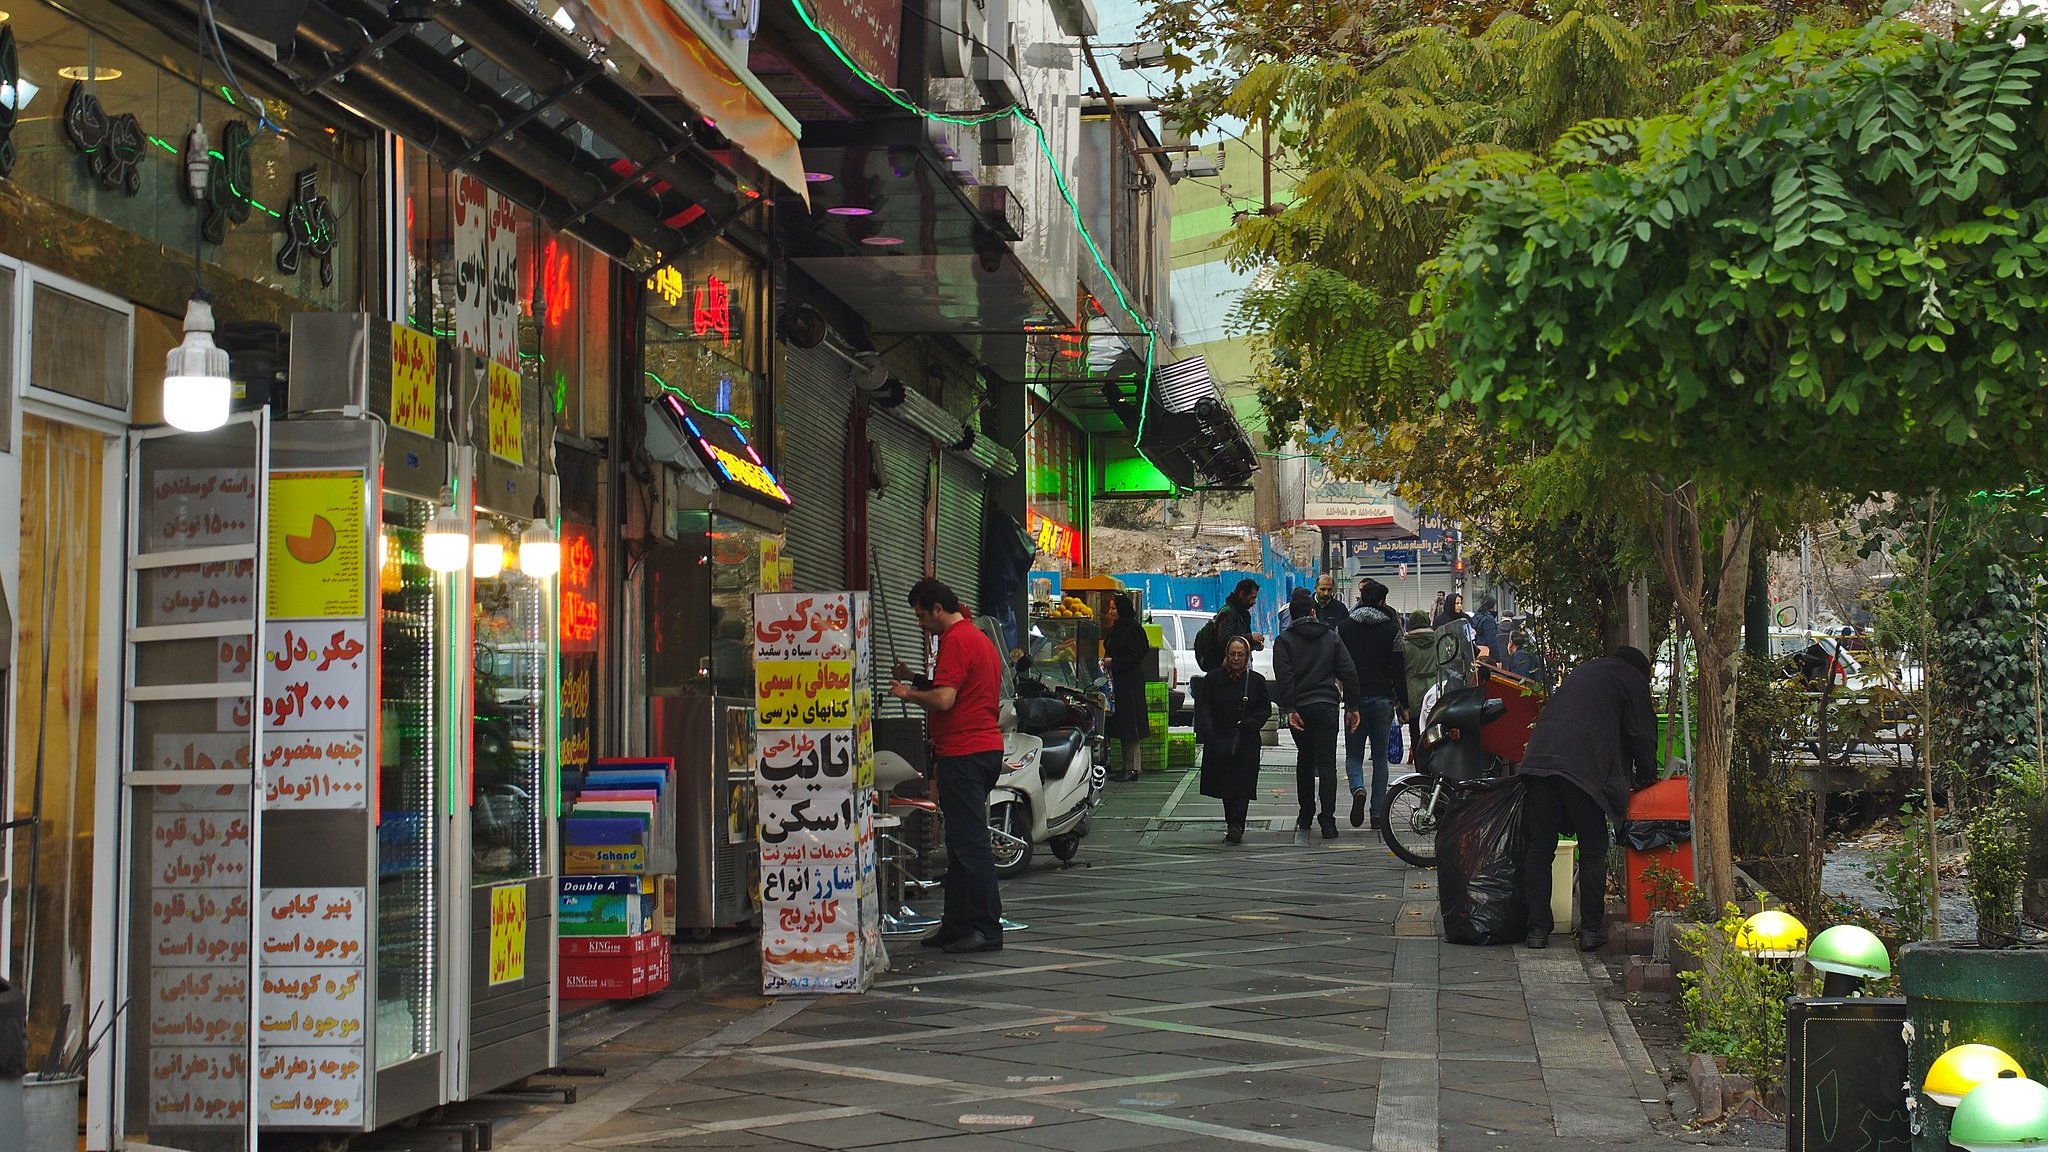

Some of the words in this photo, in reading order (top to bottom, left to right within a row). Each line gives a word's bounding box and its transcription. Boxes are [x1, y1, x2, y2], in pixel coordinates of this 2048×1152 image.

[456, 238, 486, 308] درسی
[756, 594, 849, 645] فتوکپی
[758, 644, 781, 660] سفید
[791, 645, 812, 660] سیاه
[804, 662, 851, 699] صحافی
[760, 702, 799, 724] درسی
[802, 698, 850, 723] کتابهای
[262, 738, 322, 768] مخصوص
[763, 733, 815, 758] طراحی
[760, 732, 851, 799] تایپ
[761, 798, 852, 844] اسکن
[597, 850, 637, 860] Sahand
[810, 842, 854, 860] خدمات
[563, 881, 604, 891] Double
[607, 881, 616, 890] A
[763, 867, 810, 901] انواع
[812, 865, 854, 899] شارژ
[271, 894, 319, 920] کبابی
[321, 897, 353, 921] پنیر
[779, 899, 839, 933] کارتریج
[158, 932, 193, 955] است
[263, 933, 300, 953] است
[303, 936, 359, 959] موجود
[589, 941, 610, 950] KING
[160, 973, 213, 1003] کبابی
[566, 976, 587, 985] KING
[151, 1011, 193, 1035] است
[259, 1011, 299, 1032] است
[302, 1014, 360, 1037] موجود
[153, 1053, 219, 1080] زعفرانی
[259, 1055, 317, 1080] زعفرانی
[319, 1061, 360, 1080] جوجه
[154, 1092, 191, 1113] است
[269, 1091, 301, 1110] است
[303, 1096, 350, 1116] موجود
